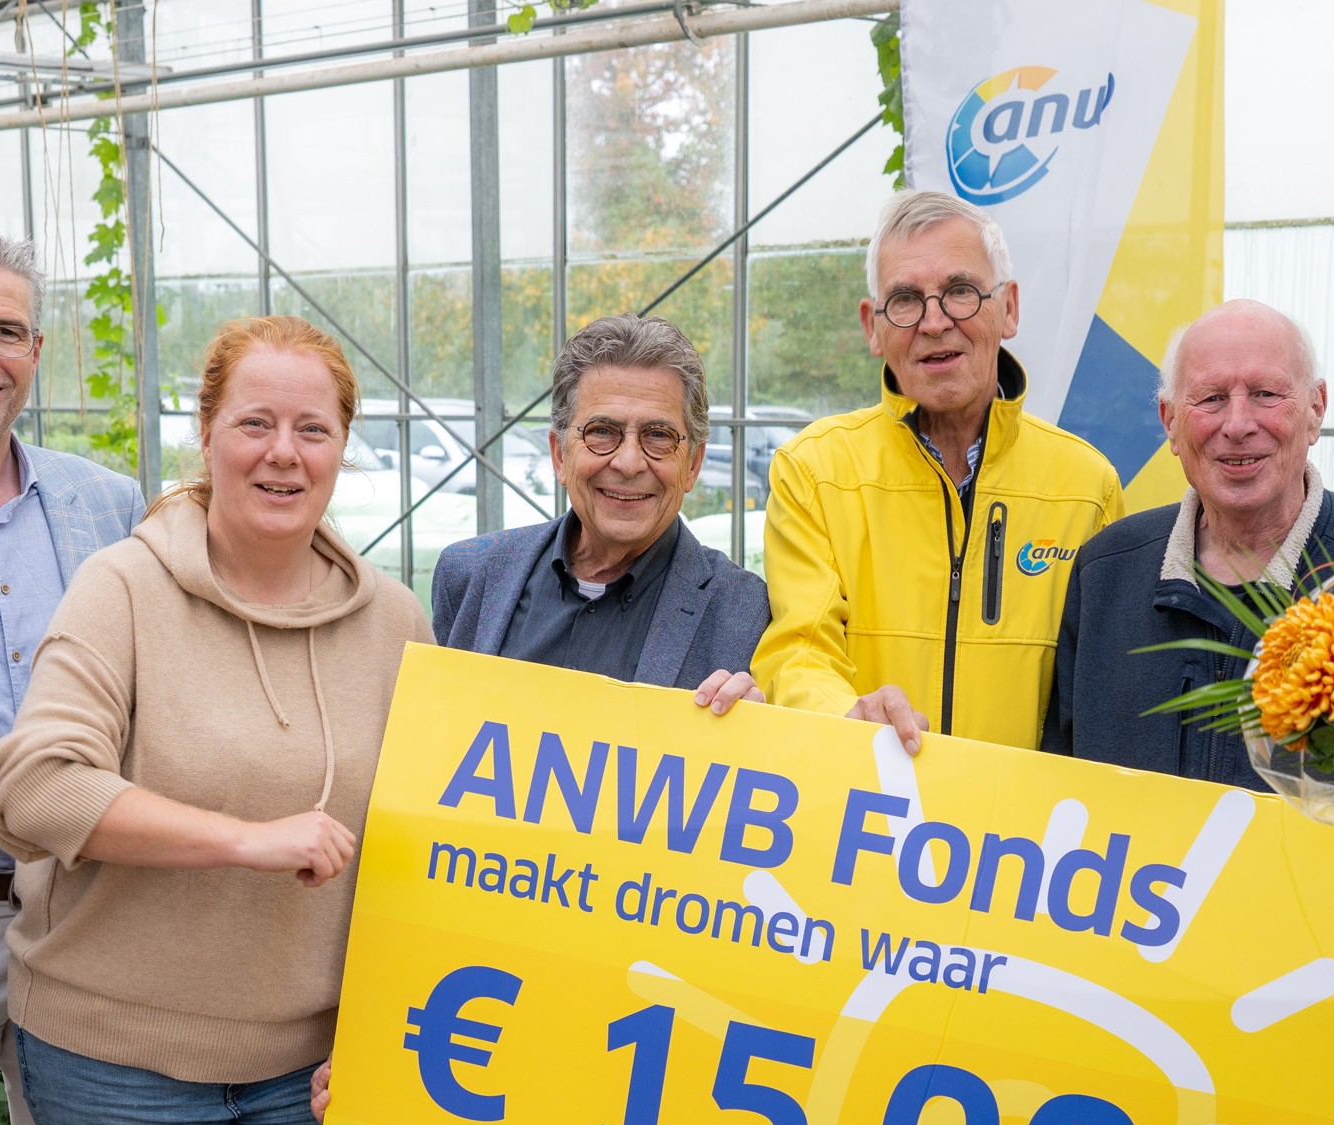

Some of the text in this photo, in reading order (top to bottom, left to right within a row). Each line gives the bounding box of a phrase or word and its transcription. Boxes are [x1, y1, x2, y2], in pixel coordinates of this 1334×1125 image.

[440, 722, 1187, 946] ANWB Fonds
[428, 842, 1007, 993] maakt dromen waar
[404, 966, 523, 1121] €
